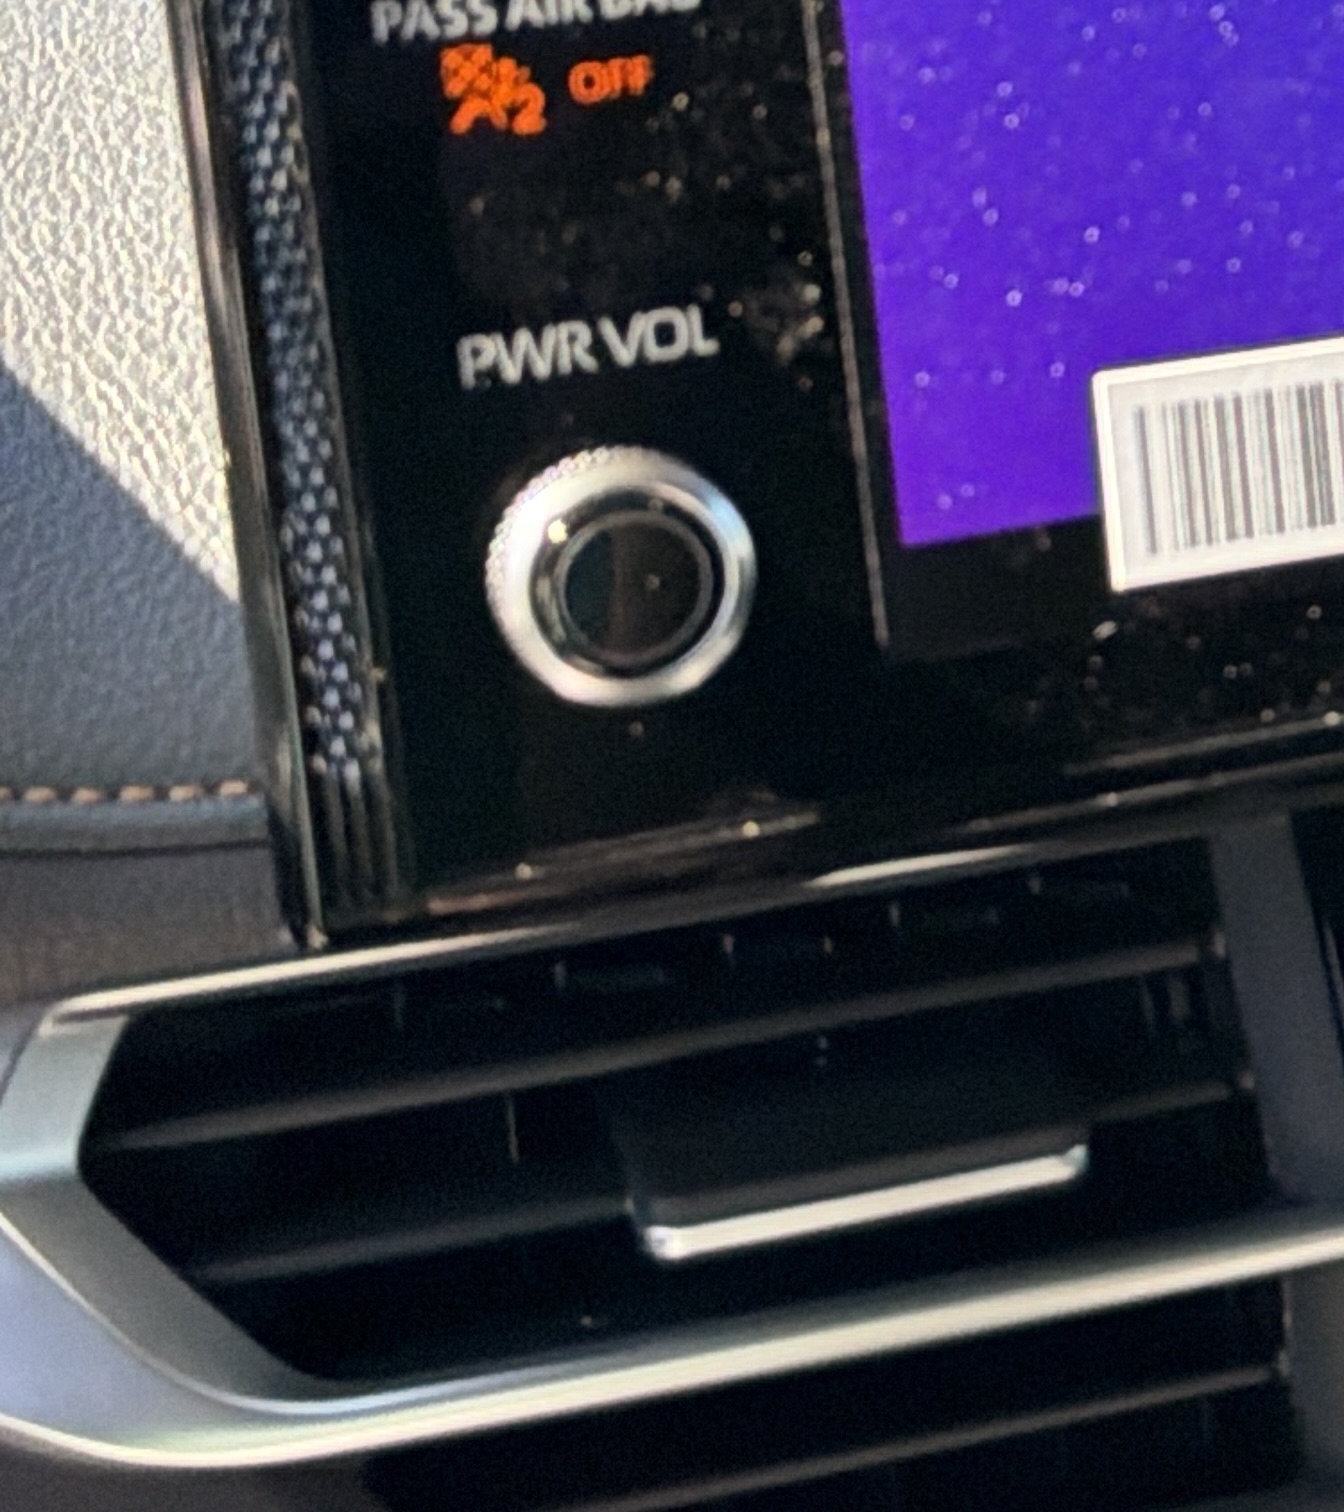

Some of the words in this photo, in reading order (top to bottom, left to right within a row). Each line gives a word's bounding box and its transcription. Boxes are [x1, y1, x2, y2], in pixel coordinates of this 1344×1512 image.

[568, 55, 653, 104] OFF
[457, 320, 598, 388] PWR
[599, 305, 719, 368] VOL
